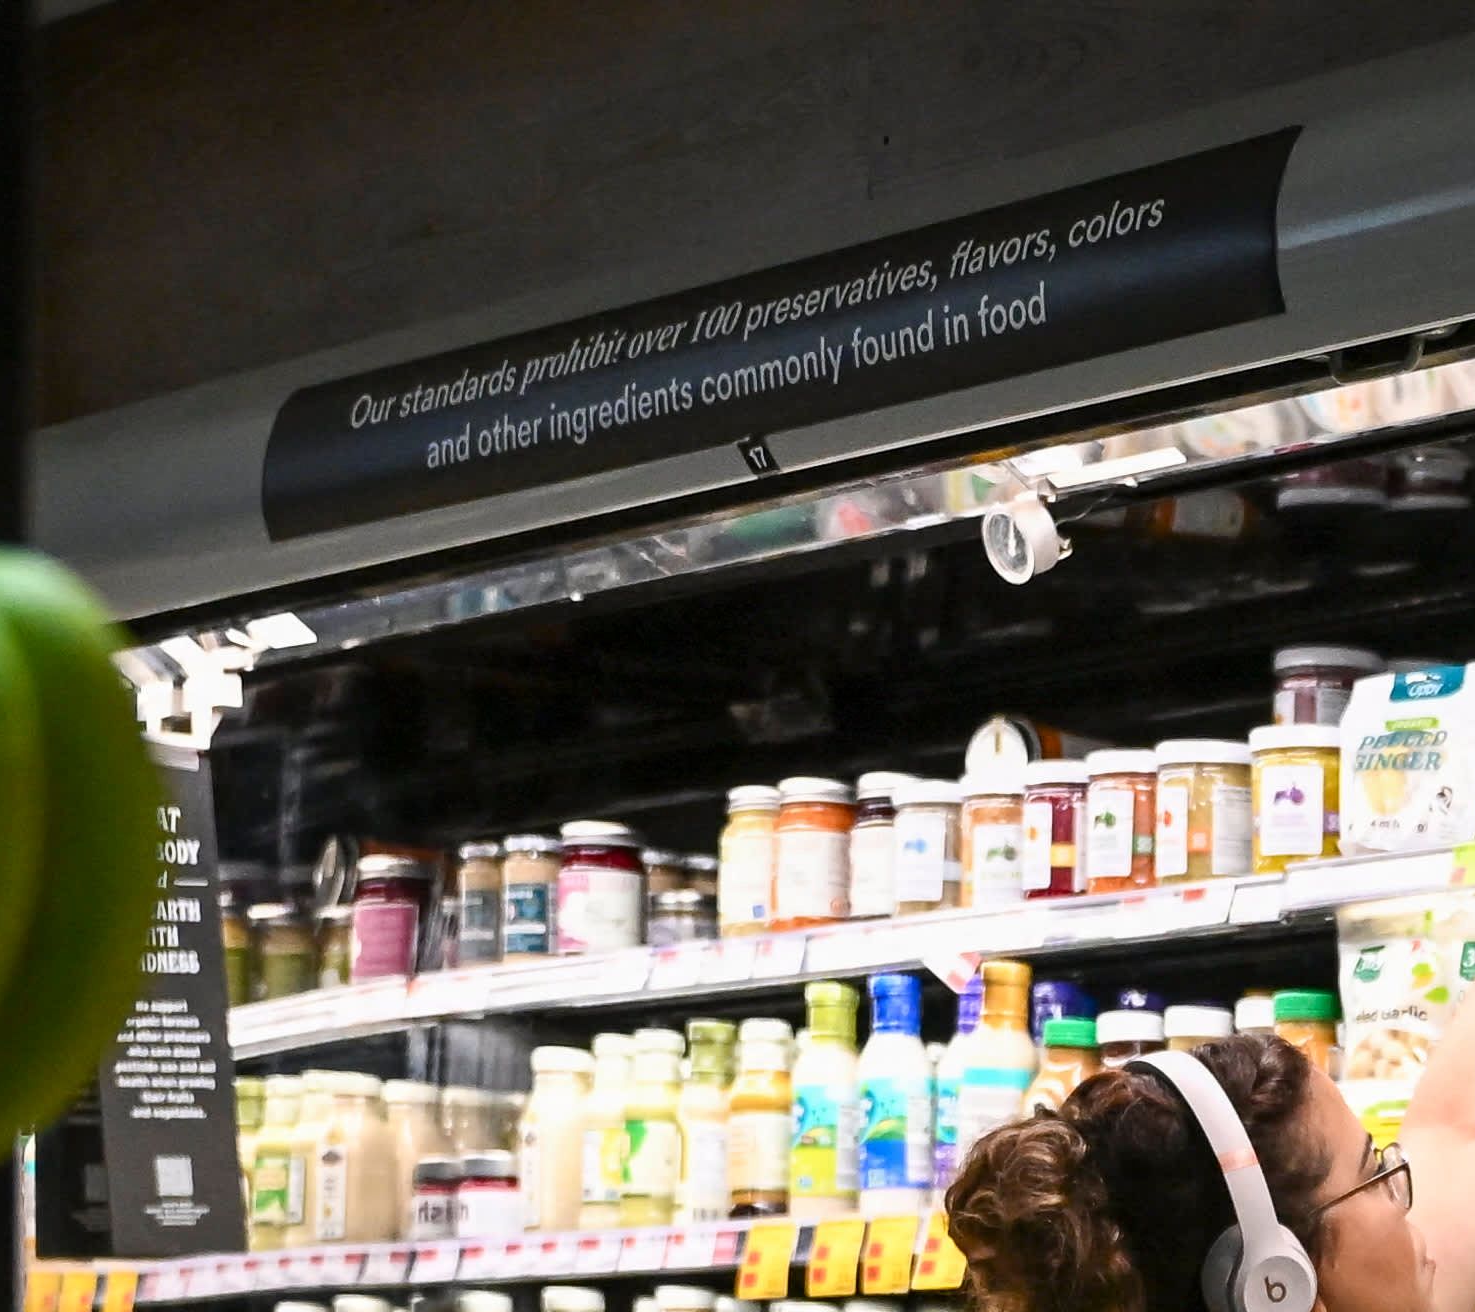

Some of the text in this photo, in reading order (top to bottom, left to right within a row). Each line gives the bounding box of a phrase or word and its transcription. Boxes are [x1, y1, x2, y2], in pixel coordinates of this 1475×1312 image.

[350, 196, 1166, 431] Our standards prohibit over 100 preservatives, flavors, colors
[426, 279, 1047, 469] and other ingredients commonly found in food
[1354, 749, 1443, 773] GINGER
[1359, 730, 1448, 751] PEELED
